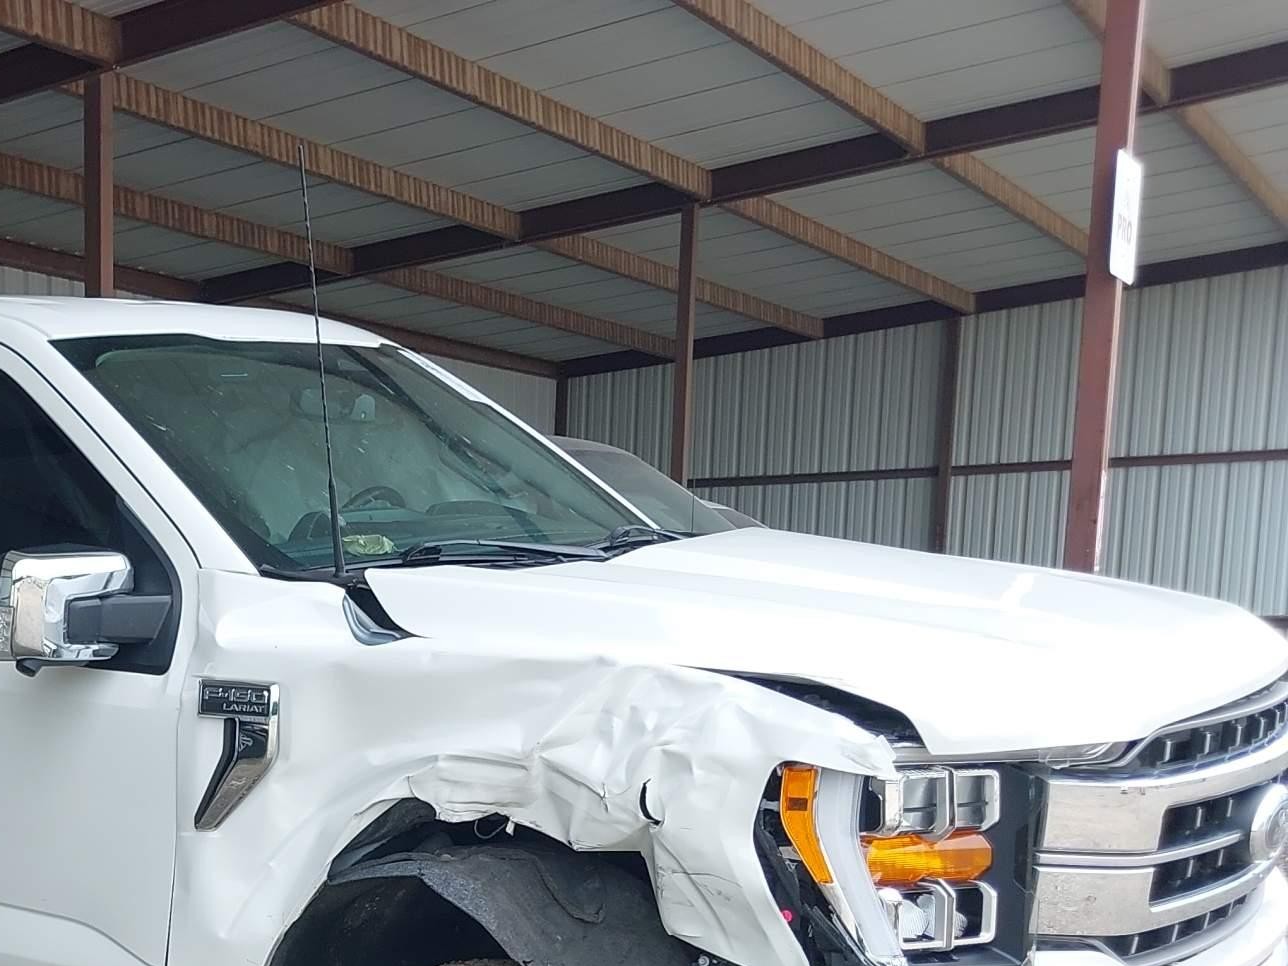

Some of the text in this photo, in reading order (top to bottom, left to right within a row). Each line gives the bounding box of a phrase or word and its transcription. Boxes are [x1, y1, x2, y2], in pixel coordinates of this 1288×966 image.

[1117, 213, 1133, 245] PRO
[203, 687, 269, 704] F-150
[223, 702, 266, 713] LARIAT
